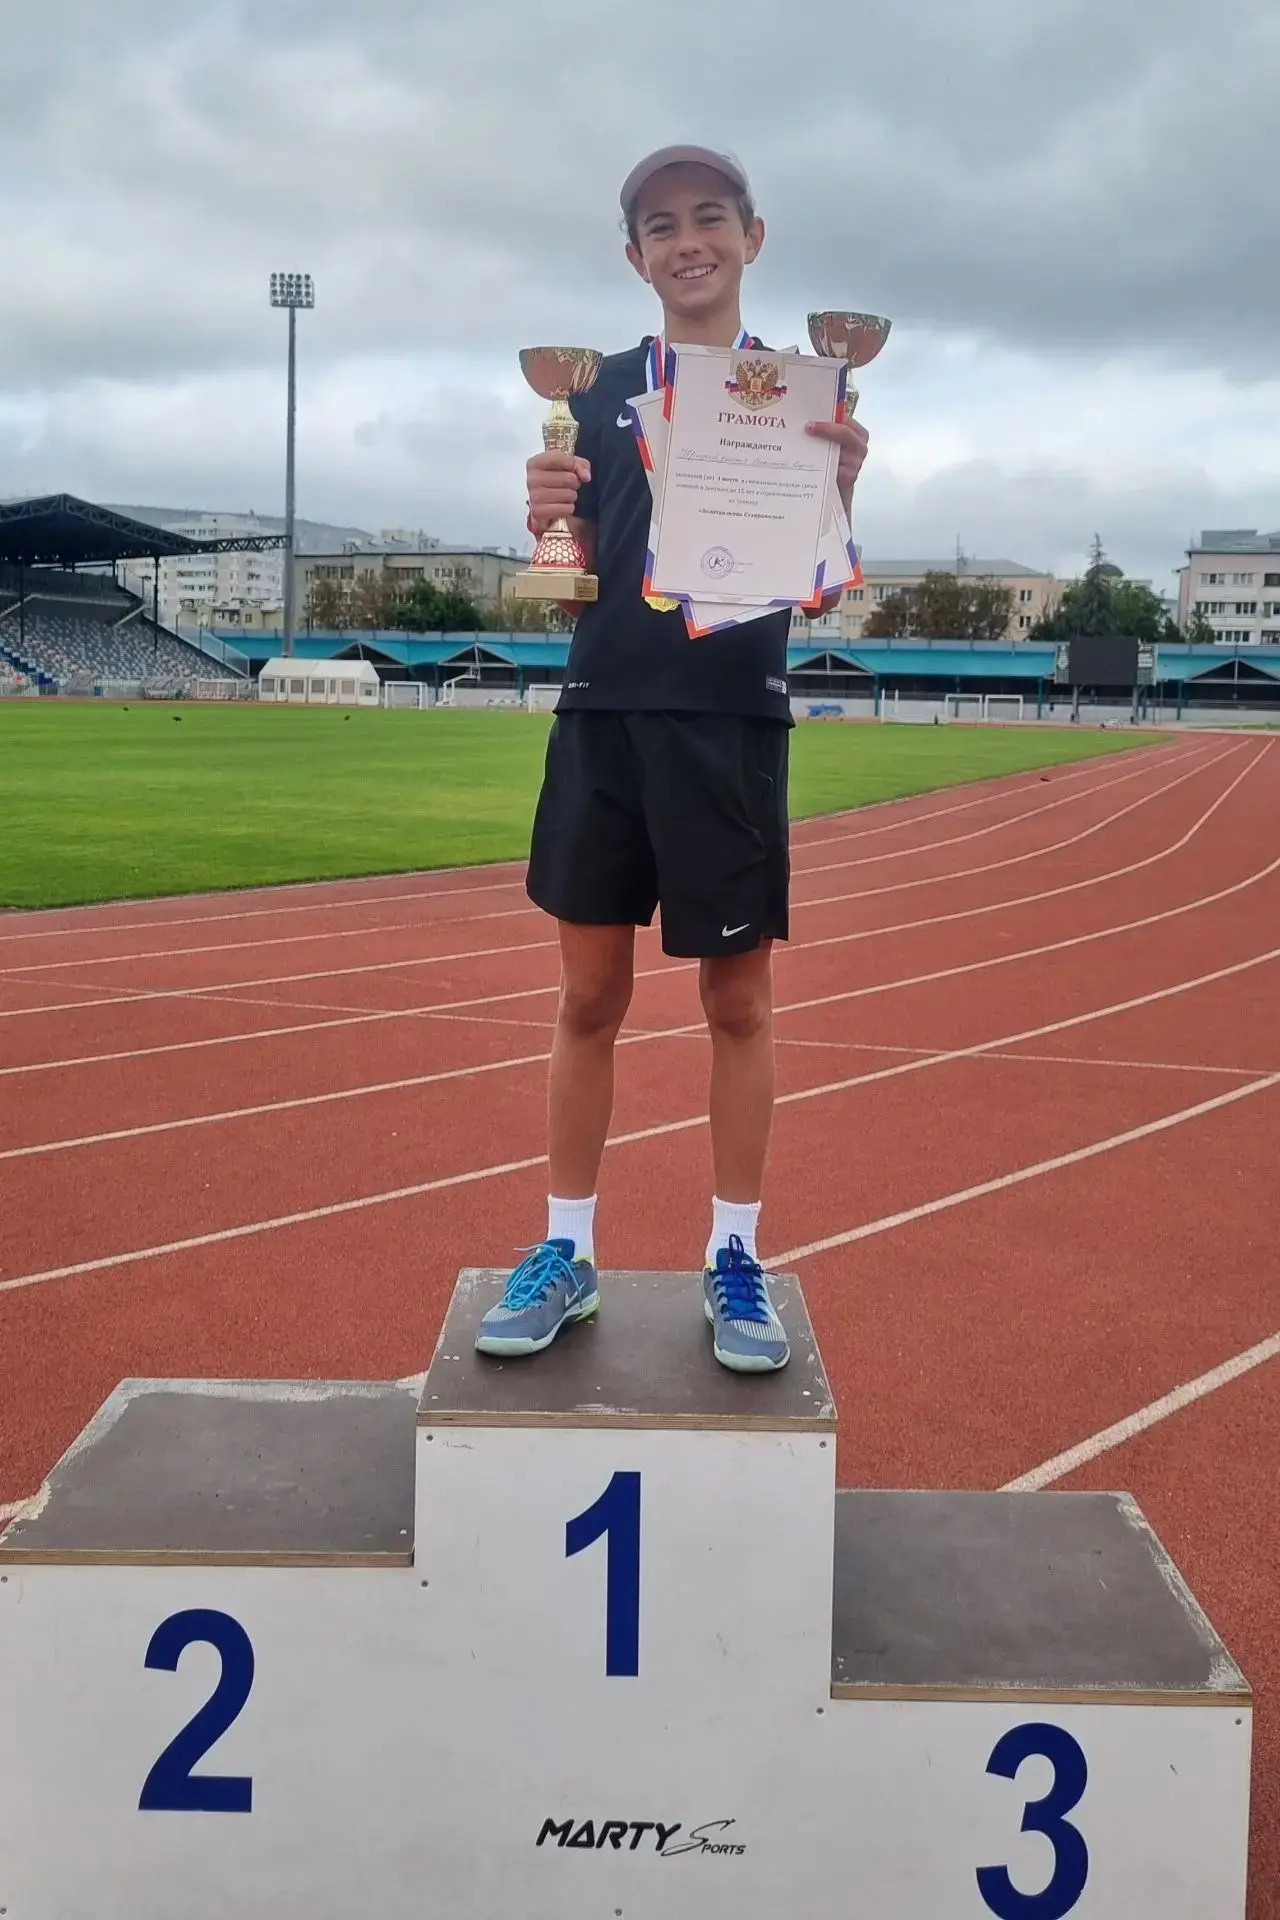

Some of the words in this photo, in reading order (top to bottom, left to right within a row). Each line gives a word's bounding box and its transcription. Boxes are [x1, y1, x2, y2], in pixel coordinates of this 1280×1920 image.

[717, 411, 787, 429] ГРАМОТА
[719, 437, 782, 452] Награждается
[565, 1471, 641, 1677] 1
[138, 1609, 255, 1813] 2
[535, 1817, 682, 1852] MARTY
[660, 1818, 747, 1857] SPORTS
[976, 1723, 1089, 1920] 3
